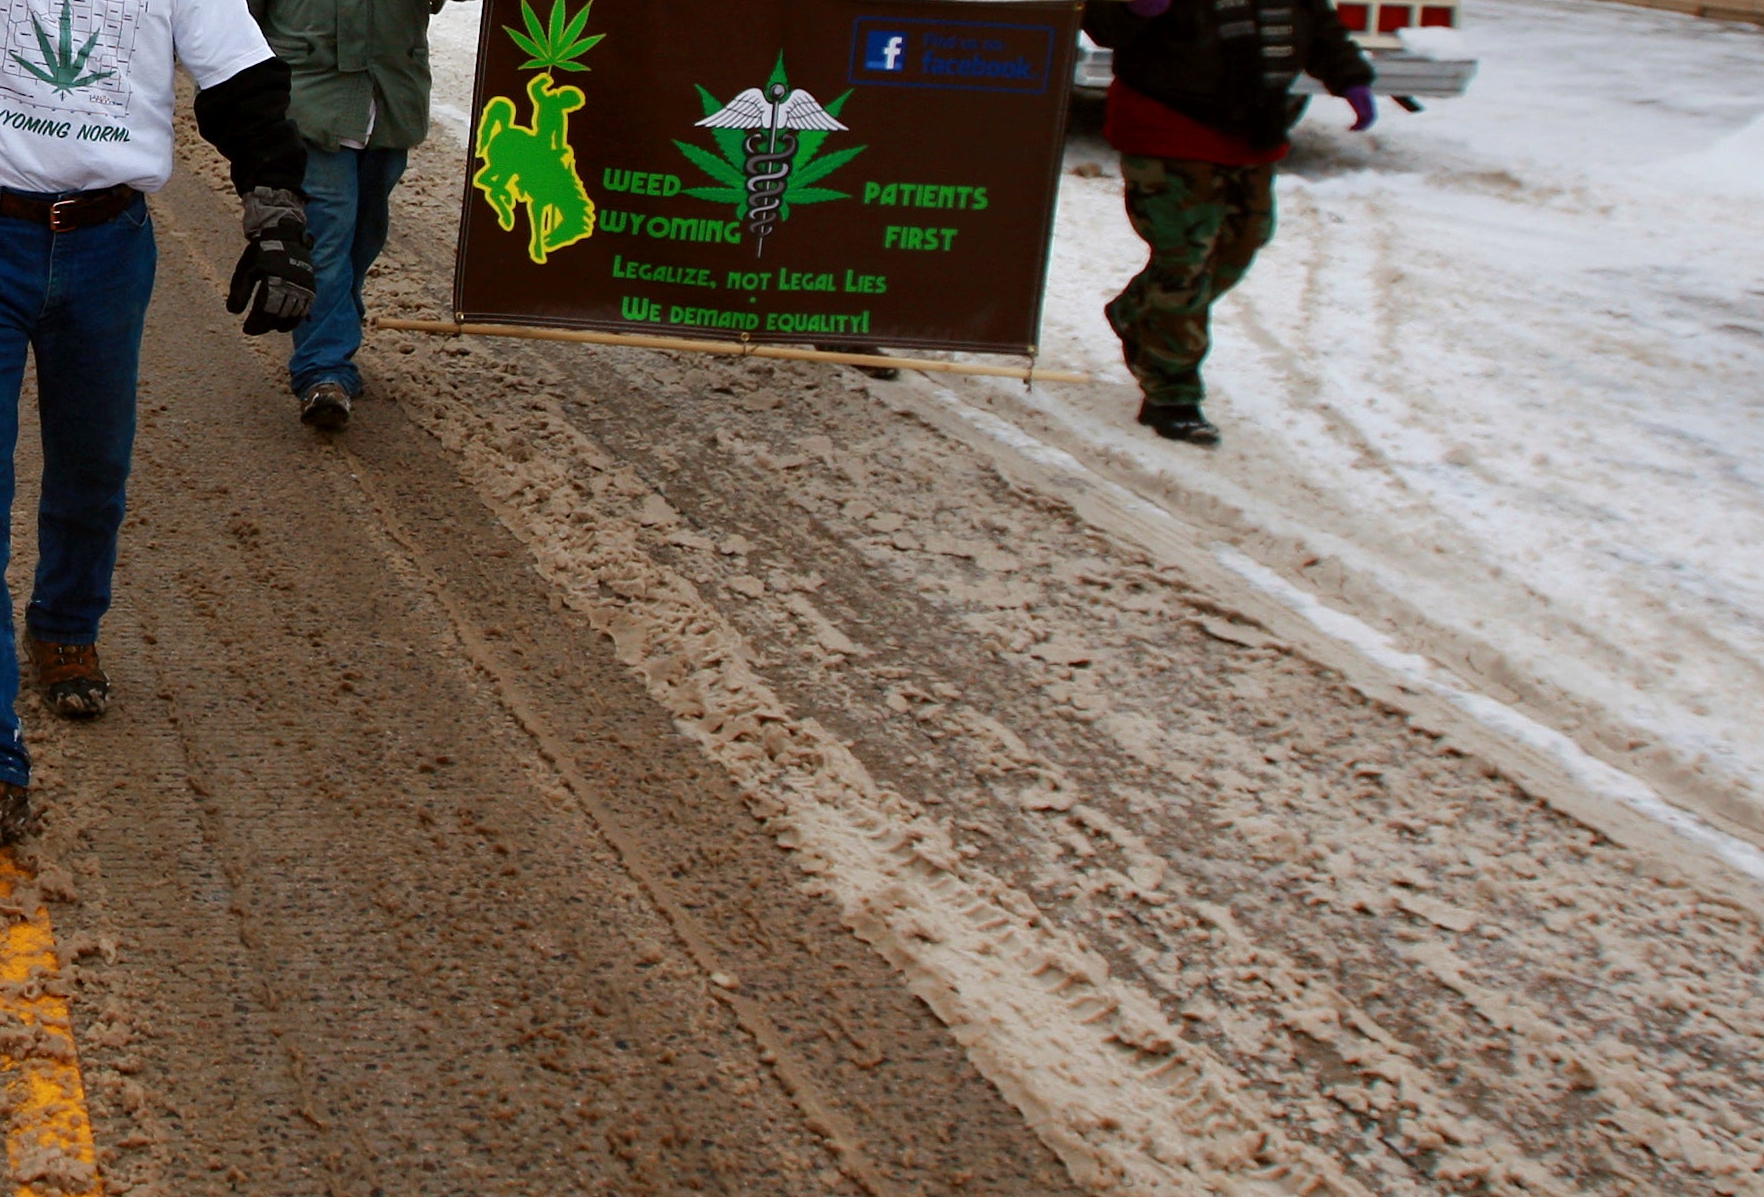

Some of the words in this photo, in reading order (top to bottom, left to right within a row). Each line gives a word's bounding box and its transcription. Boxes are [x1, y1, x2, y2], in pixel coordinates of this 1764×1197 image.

[77, 124, 131, 143] NORML
[603, 167, 682, 197] WEED
[864, 181, 989, 210] PATIENTS
[599, 209, 742, 244] WYOMING
[884, 225, 959, 252] FIRST
